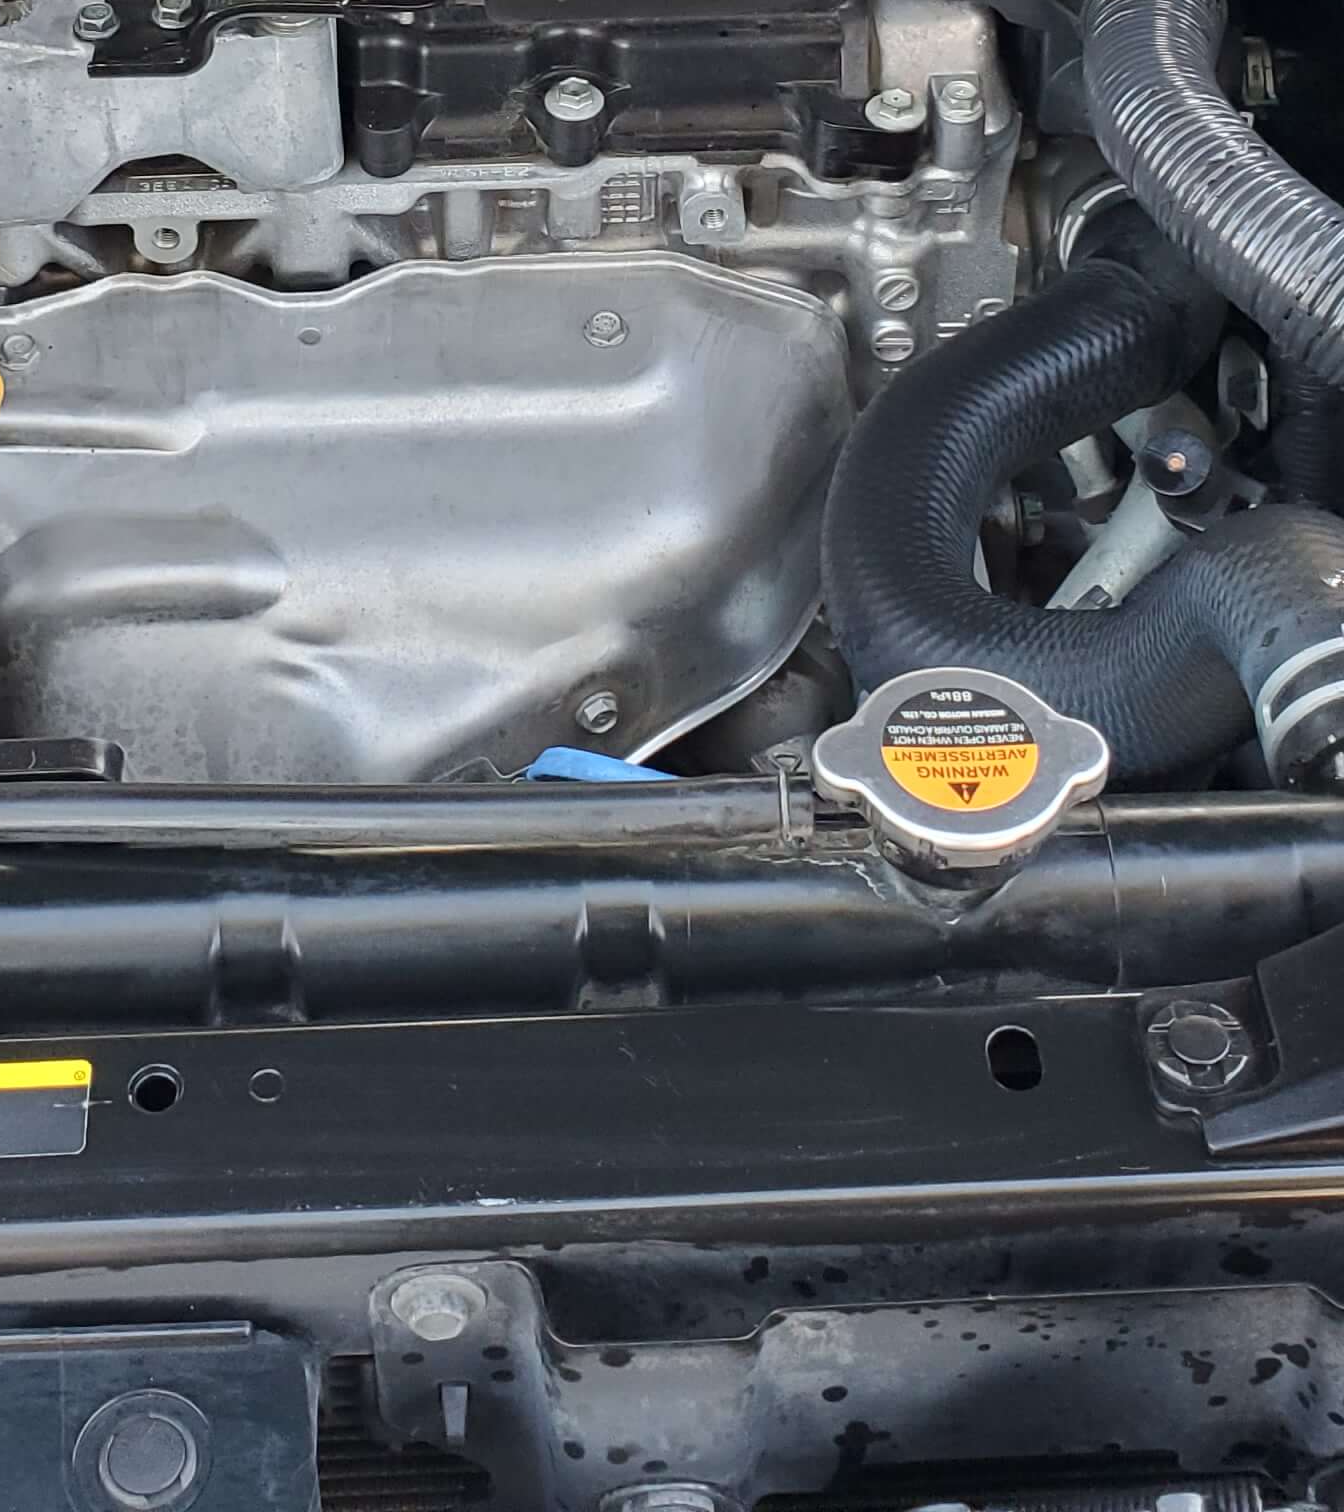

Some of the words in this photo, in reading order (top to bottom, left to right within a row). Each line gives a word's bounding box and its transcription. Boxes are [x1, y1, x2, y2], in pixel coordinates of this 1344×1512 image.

[952, 690, 973, 702] 88
[938, 710, 970, 718] MOTOR
[972, 710, 1007, 718] NISSAN
[933, 724, 971, 734] OUVRIR
[973, 723, 1009, 733] JAMAIS
[1010, 723, 1025, 732] NE
[891, 735, 916, 744] HOT.
[918, 735, 952, 744] WHEN
[954, 734, 985, 743] OPEN
[987, 733, 1024, 742] NEVER
[891, 748, 1027, 762] AVERTISSEMENT
[916, 764, 1009, 779] WARNING
